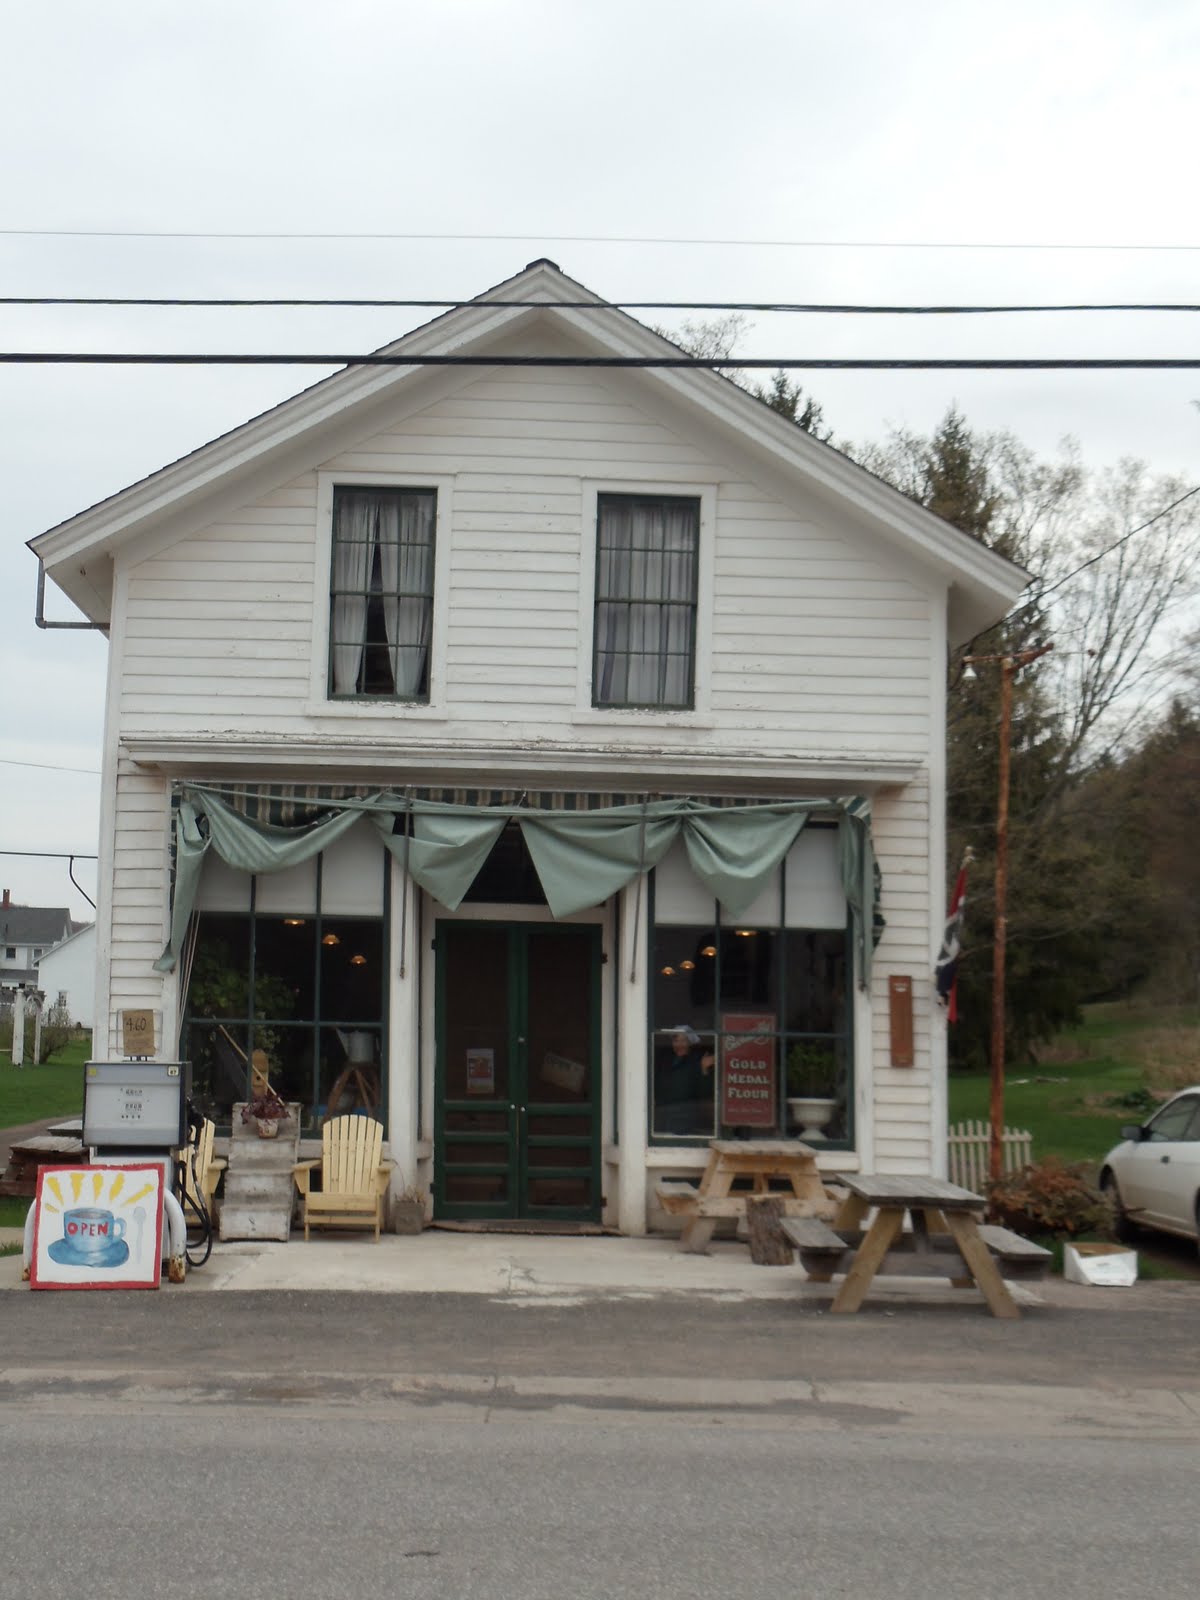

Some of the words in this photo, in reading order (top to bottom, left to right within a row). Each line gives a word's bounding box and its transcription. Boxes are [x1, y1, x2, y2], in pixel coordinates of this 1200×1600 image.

[729, 1059, 766, 1070] GOLD
[728, 1073, 769, 1084] MEDAL
[728, 1087, 769, 1099] FLOUR
[67, 1221, 109, 1237] OPEN
